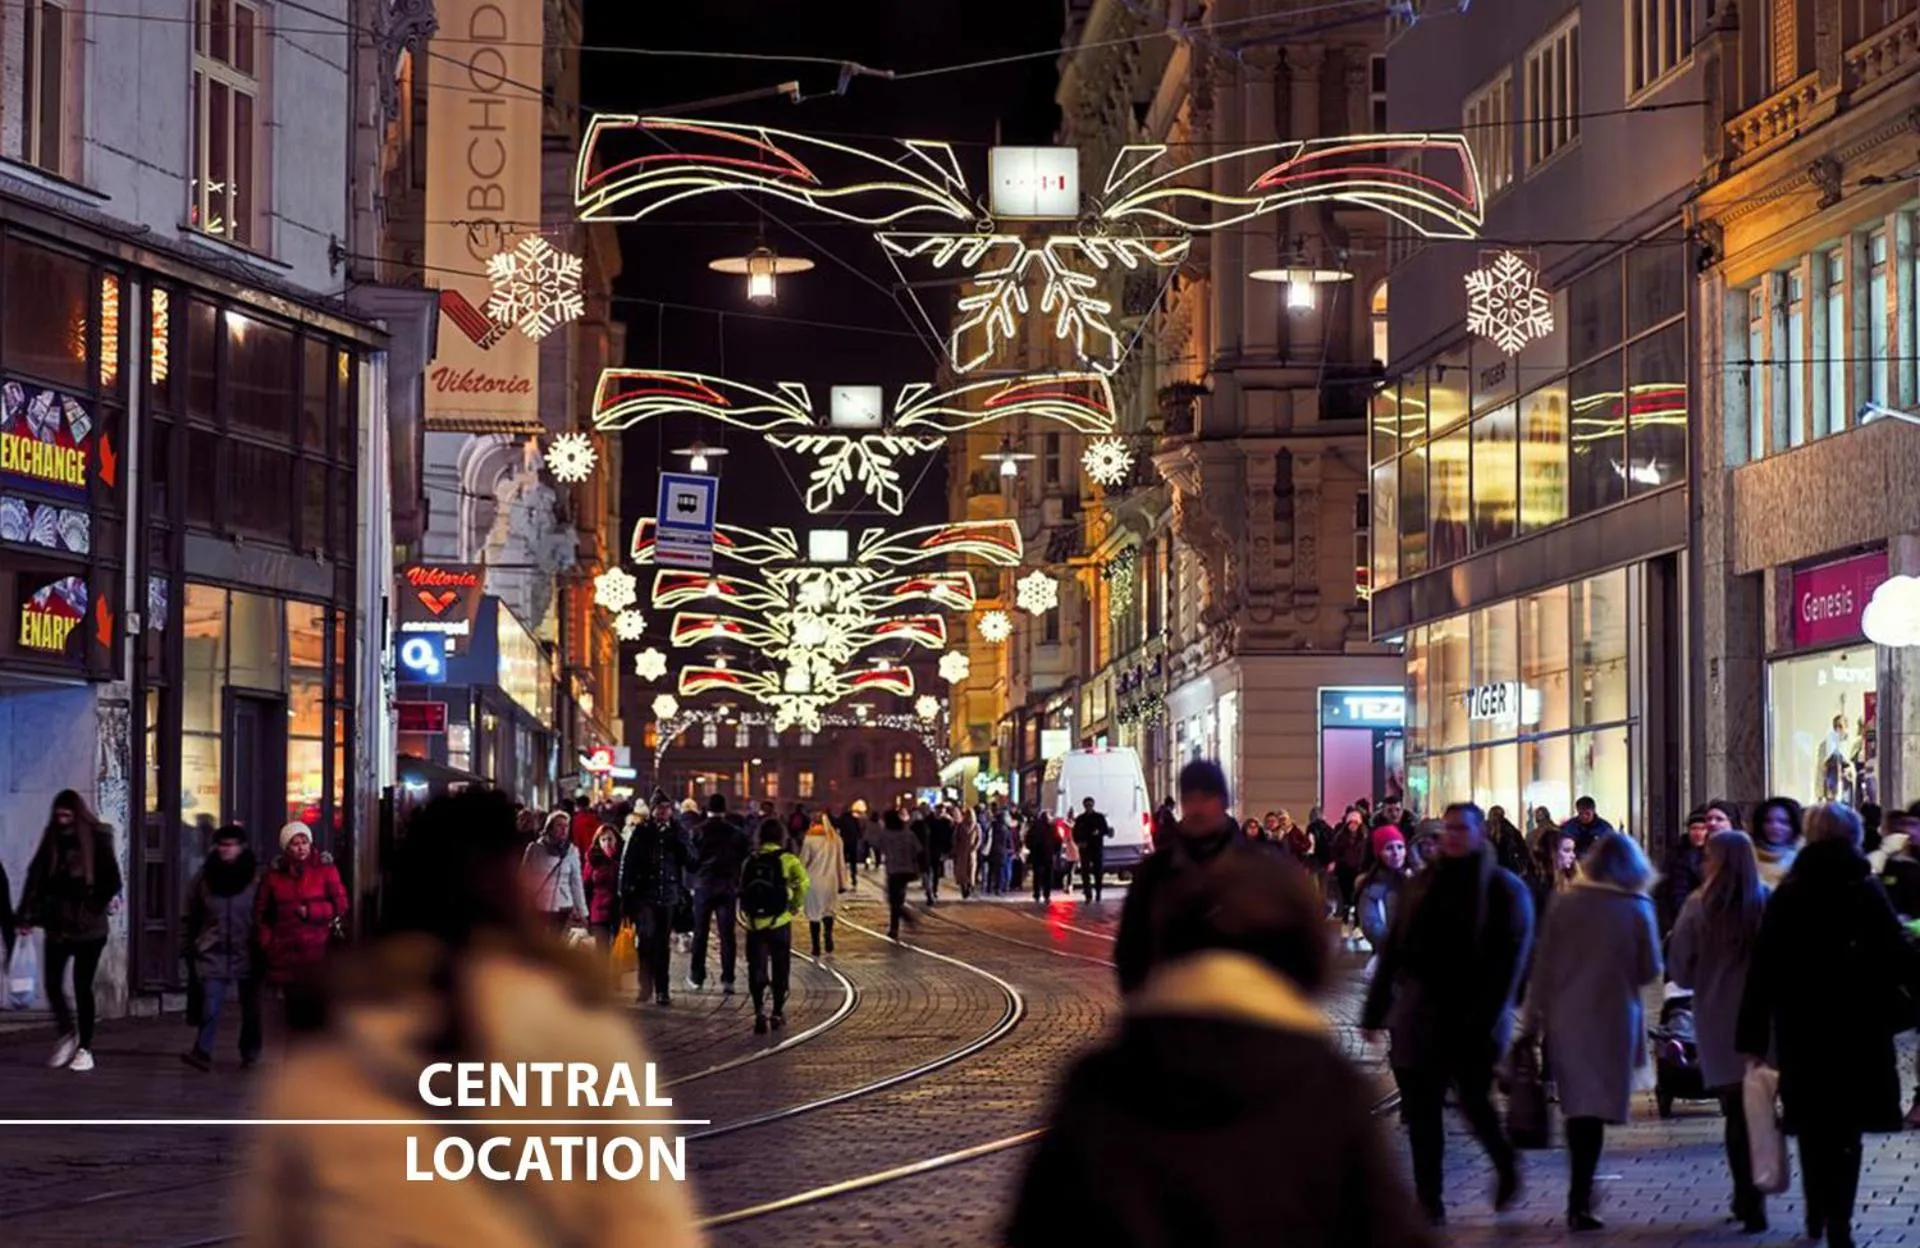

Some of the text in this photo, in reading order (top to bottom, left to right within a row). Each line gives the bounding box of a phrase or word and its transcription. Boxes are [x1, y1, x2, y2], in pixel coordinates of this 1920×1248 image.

[430, 365, 533, 395] Viktoria
[0, 432, 87, 487] EXCHANGE
[405, 565, 480, 588] Viktoria
[1801, 584, 1854, 623] Genesis
[1466, 682, 1508, 719] TIGER
